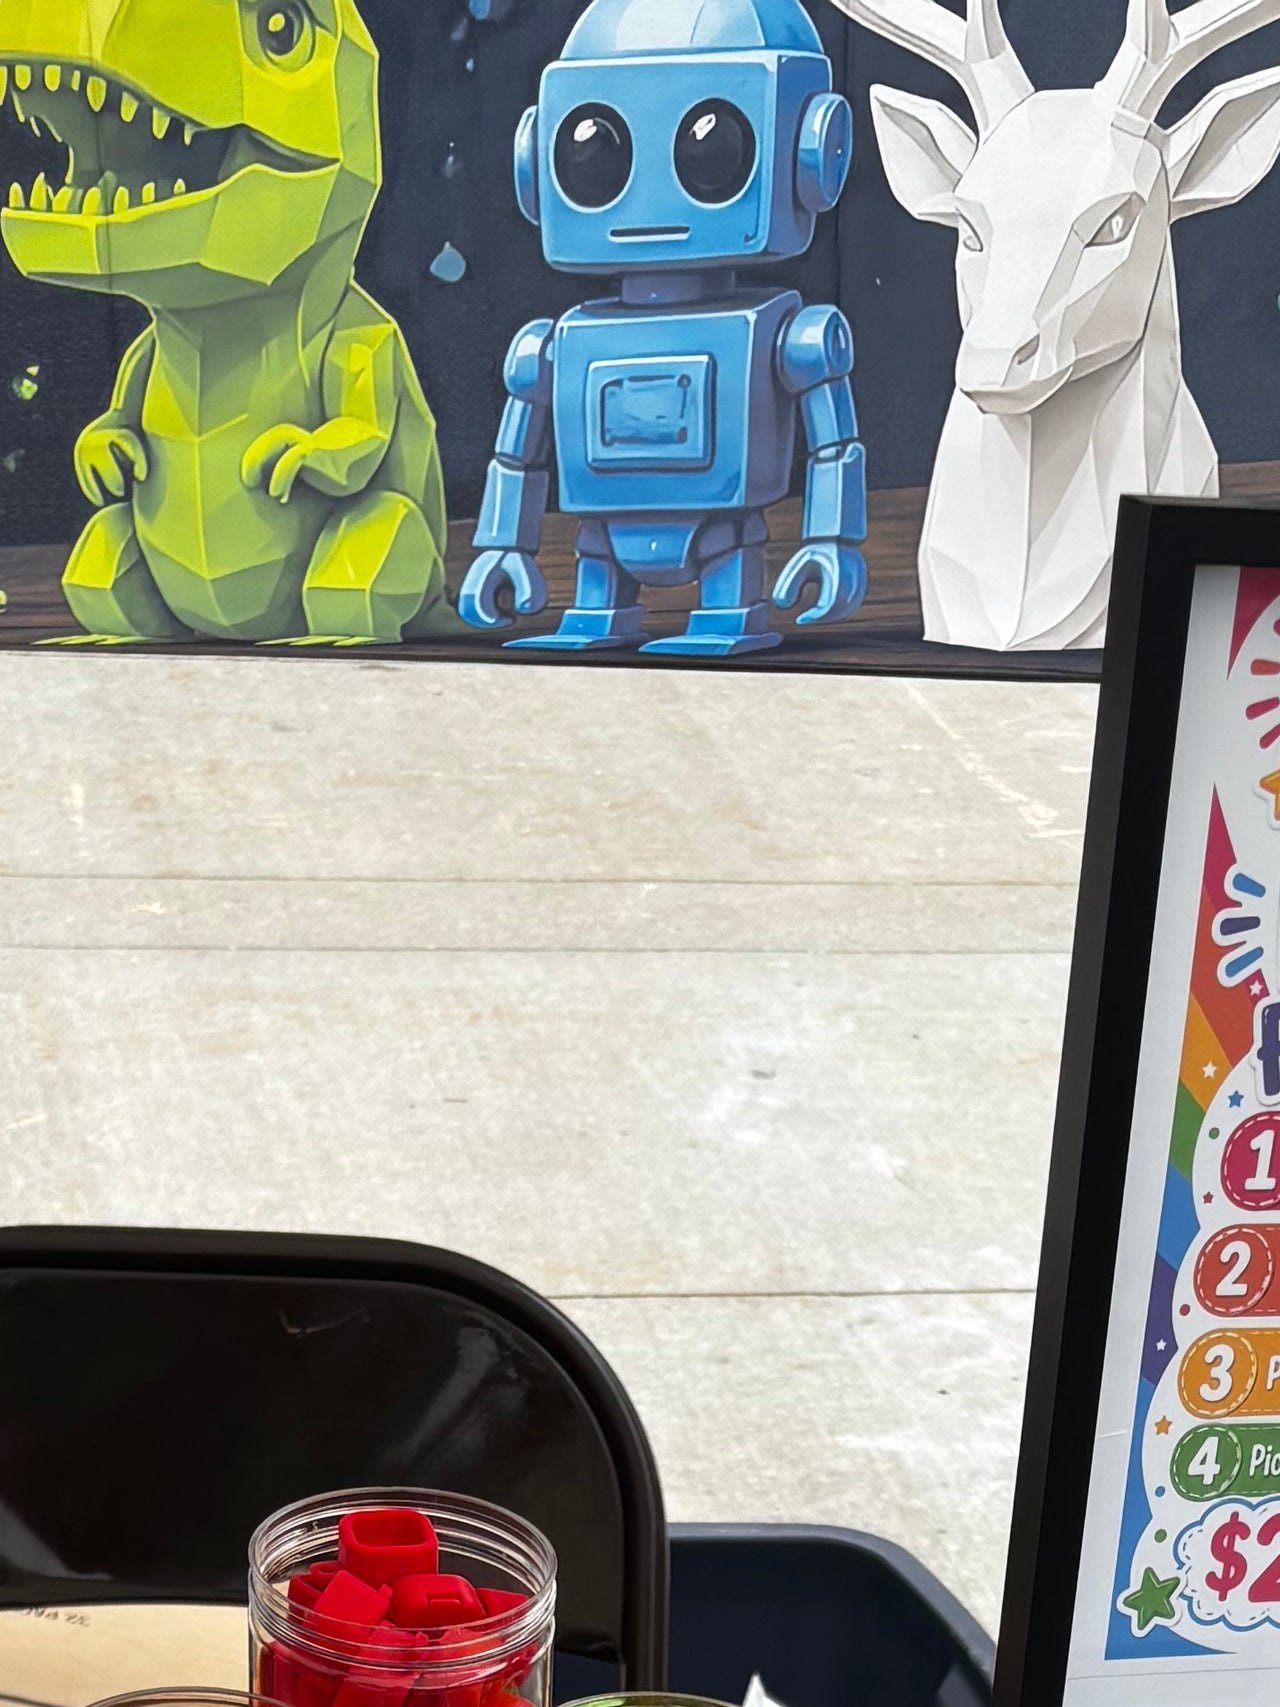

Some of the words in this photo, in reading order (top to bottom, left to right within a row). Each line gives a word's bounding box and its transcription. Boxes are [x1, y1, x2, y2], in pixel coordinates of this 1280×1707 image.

[1244, 1128, 1278, 1192] 1
[1216, 1244, 1251, 1298] 2
[1197, 1345, 1237, 1401] 3
[1186, 1439, 1223, 1484] 4
